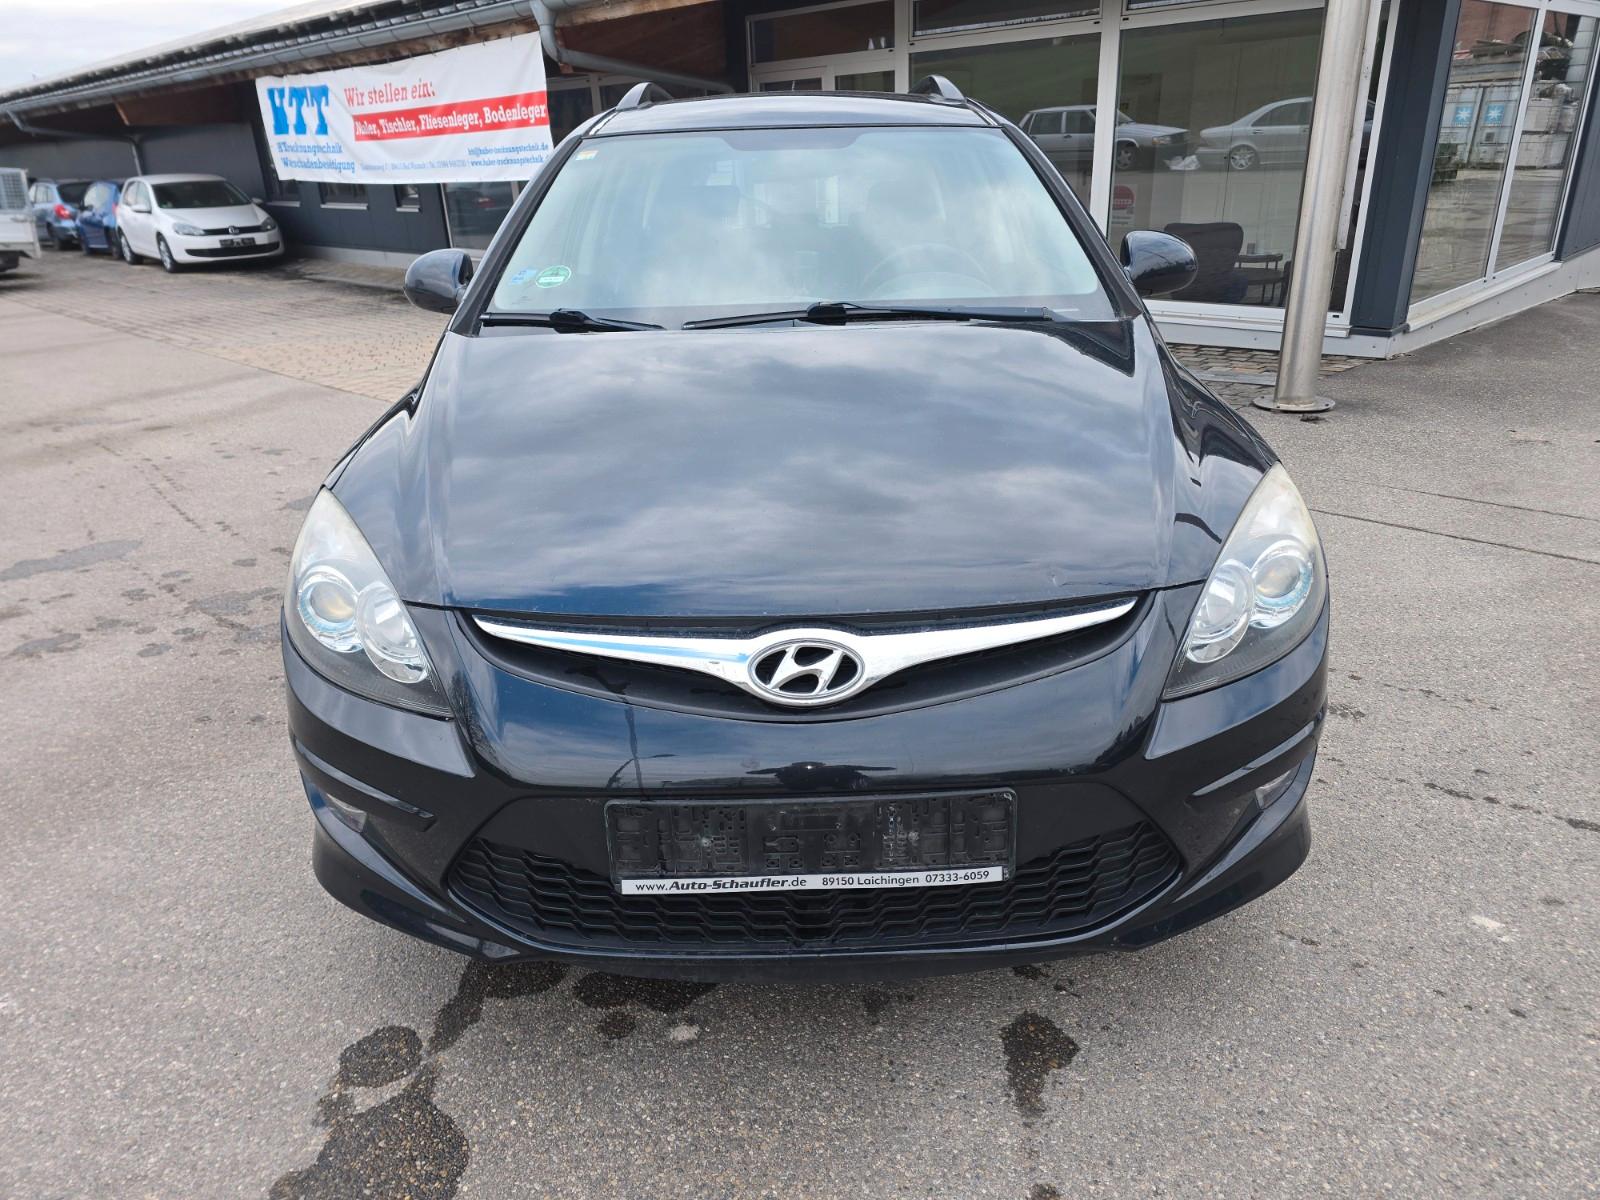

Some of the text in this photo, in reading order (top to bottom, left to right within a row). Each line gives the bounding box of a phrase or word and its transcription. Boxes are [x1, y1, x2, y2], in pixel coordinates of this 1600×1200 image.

[344, 78, 435, 107] Wir stellen ein:
[379, 117, 419, 133] Tischler,
[418, 110, 483, 130] Fliesenleger,
[483, 104, 546, 124] Bodenleger
[635, 870, 990, 892] www.Auto-Schaufler.de 89150 Laichingen 07333-6059
